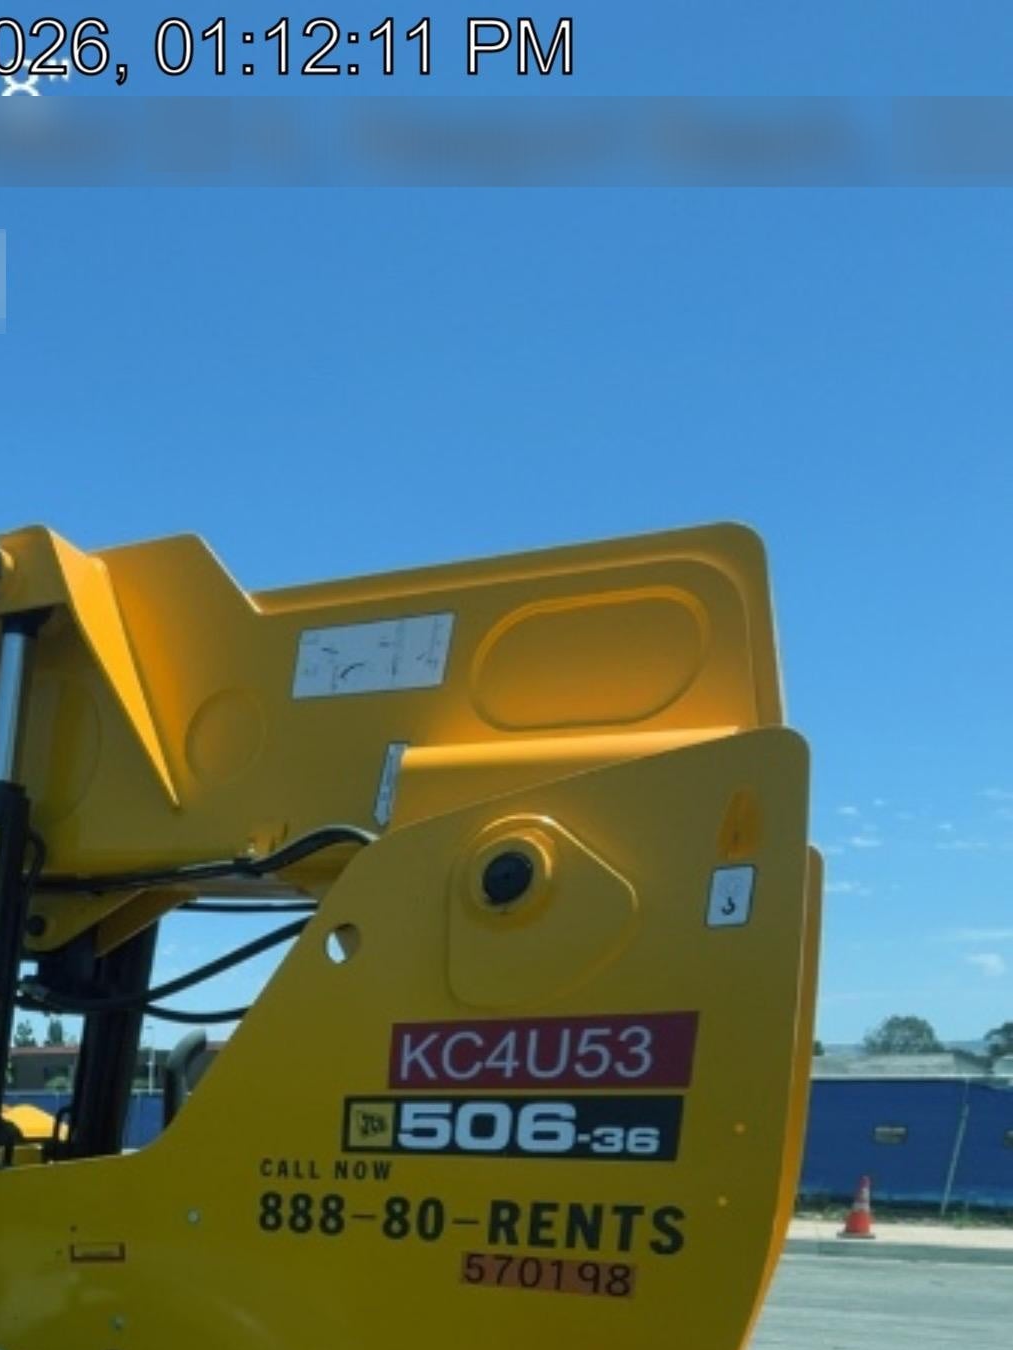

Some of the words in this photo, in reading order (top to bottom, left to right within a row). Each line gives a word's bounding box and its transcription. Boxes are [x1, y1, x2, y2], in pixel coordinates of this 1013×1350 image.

[400, 1024, 653, 1081] KC4U53
[397, 1102, 660, 1154] 506-36
[259, 1157, 321, 1181] CALL
[334, 1160, 392, 1181] NOW
[463, 1252, 633, 1298] 570198
